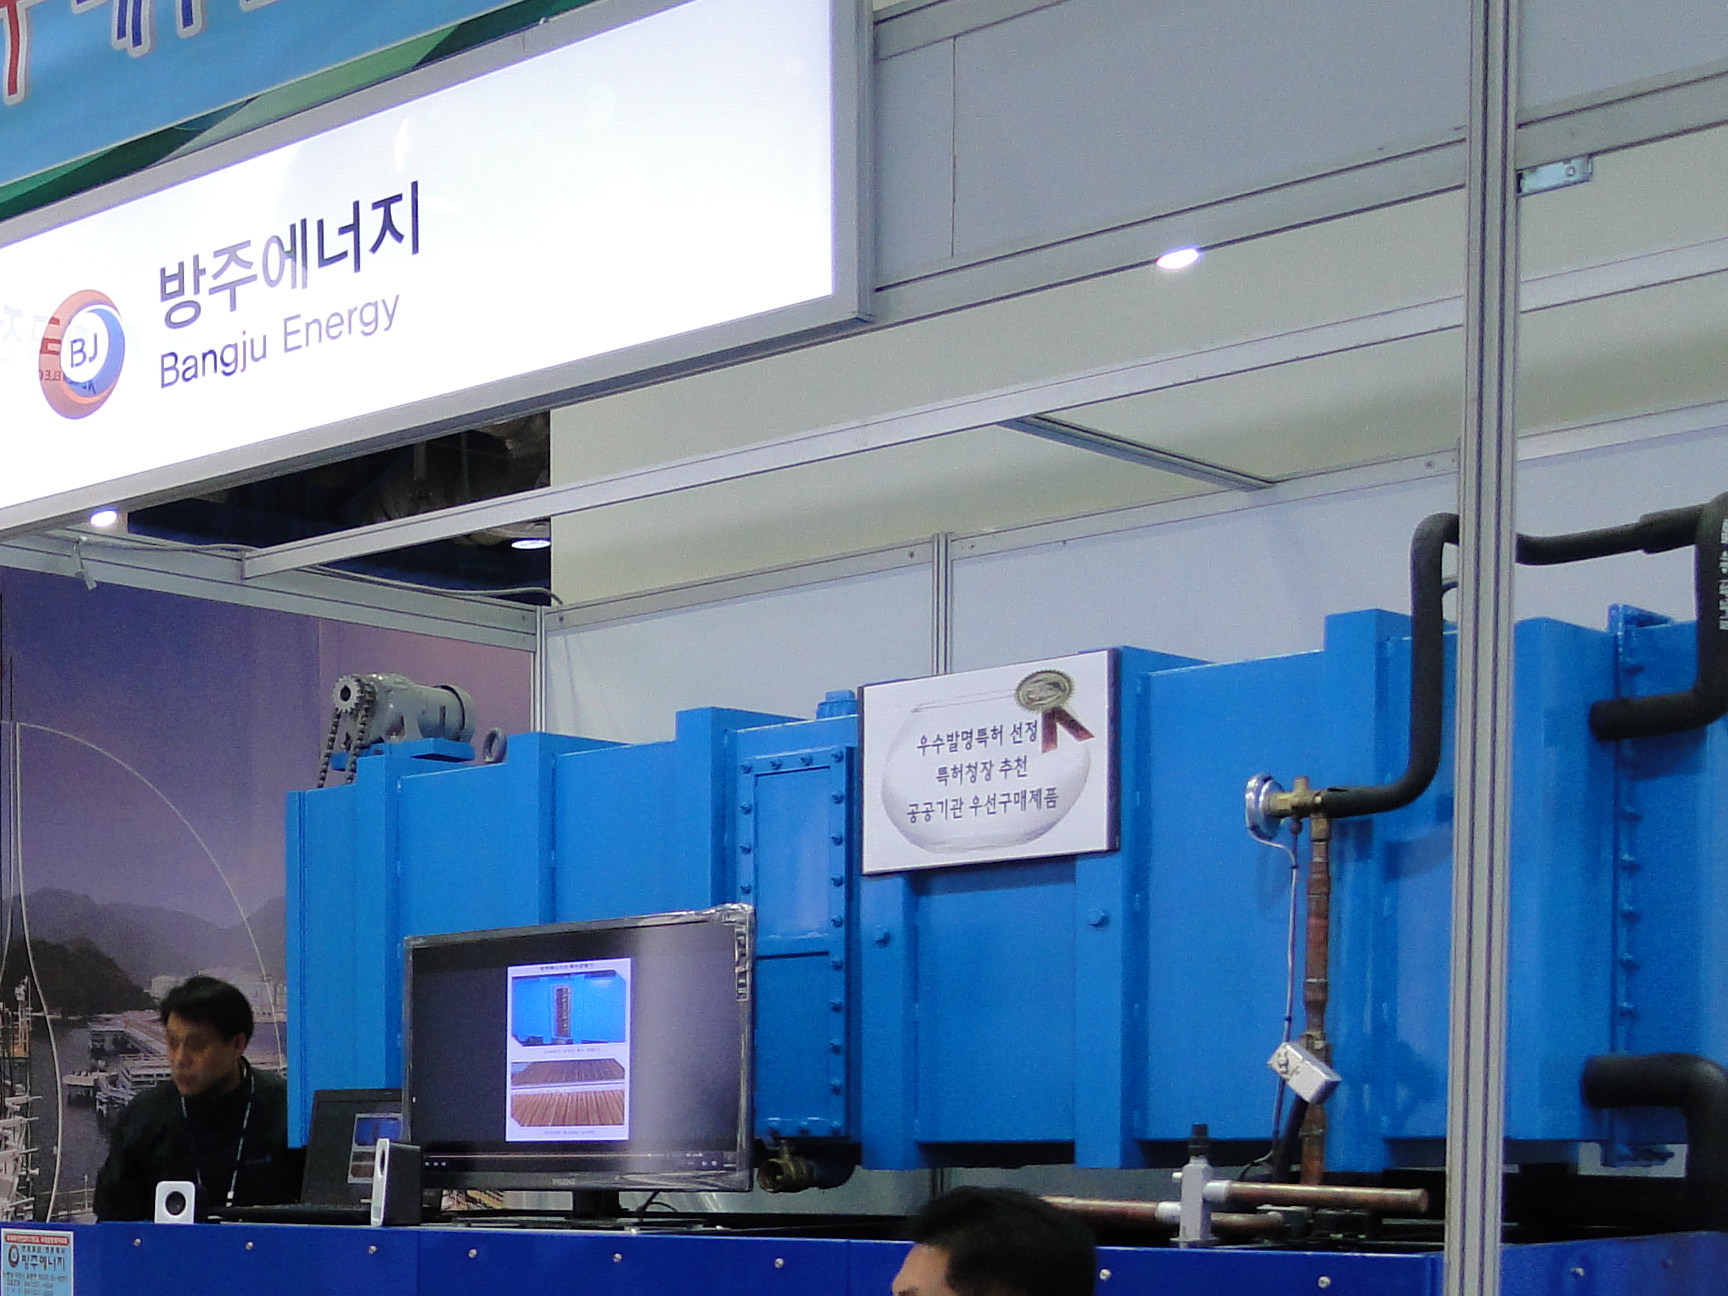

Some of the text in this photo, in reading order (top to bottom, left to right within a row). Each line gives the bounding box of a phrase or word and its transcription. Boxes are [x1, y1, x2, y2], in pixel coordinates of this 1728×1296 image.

[160, 180, 419, 329] 방주에너지
[70, 333, 98, 368] BJ
[161, 331, 267, 389] Bangju
[284, 294, 400, 353] Energy
[917, 719, 1038, 756] 우수발명특허 선정
[936, 755, 1028, 787] 특허청장 추천
[906, 787, 1059, 824] 공공기관 우선구매제품
